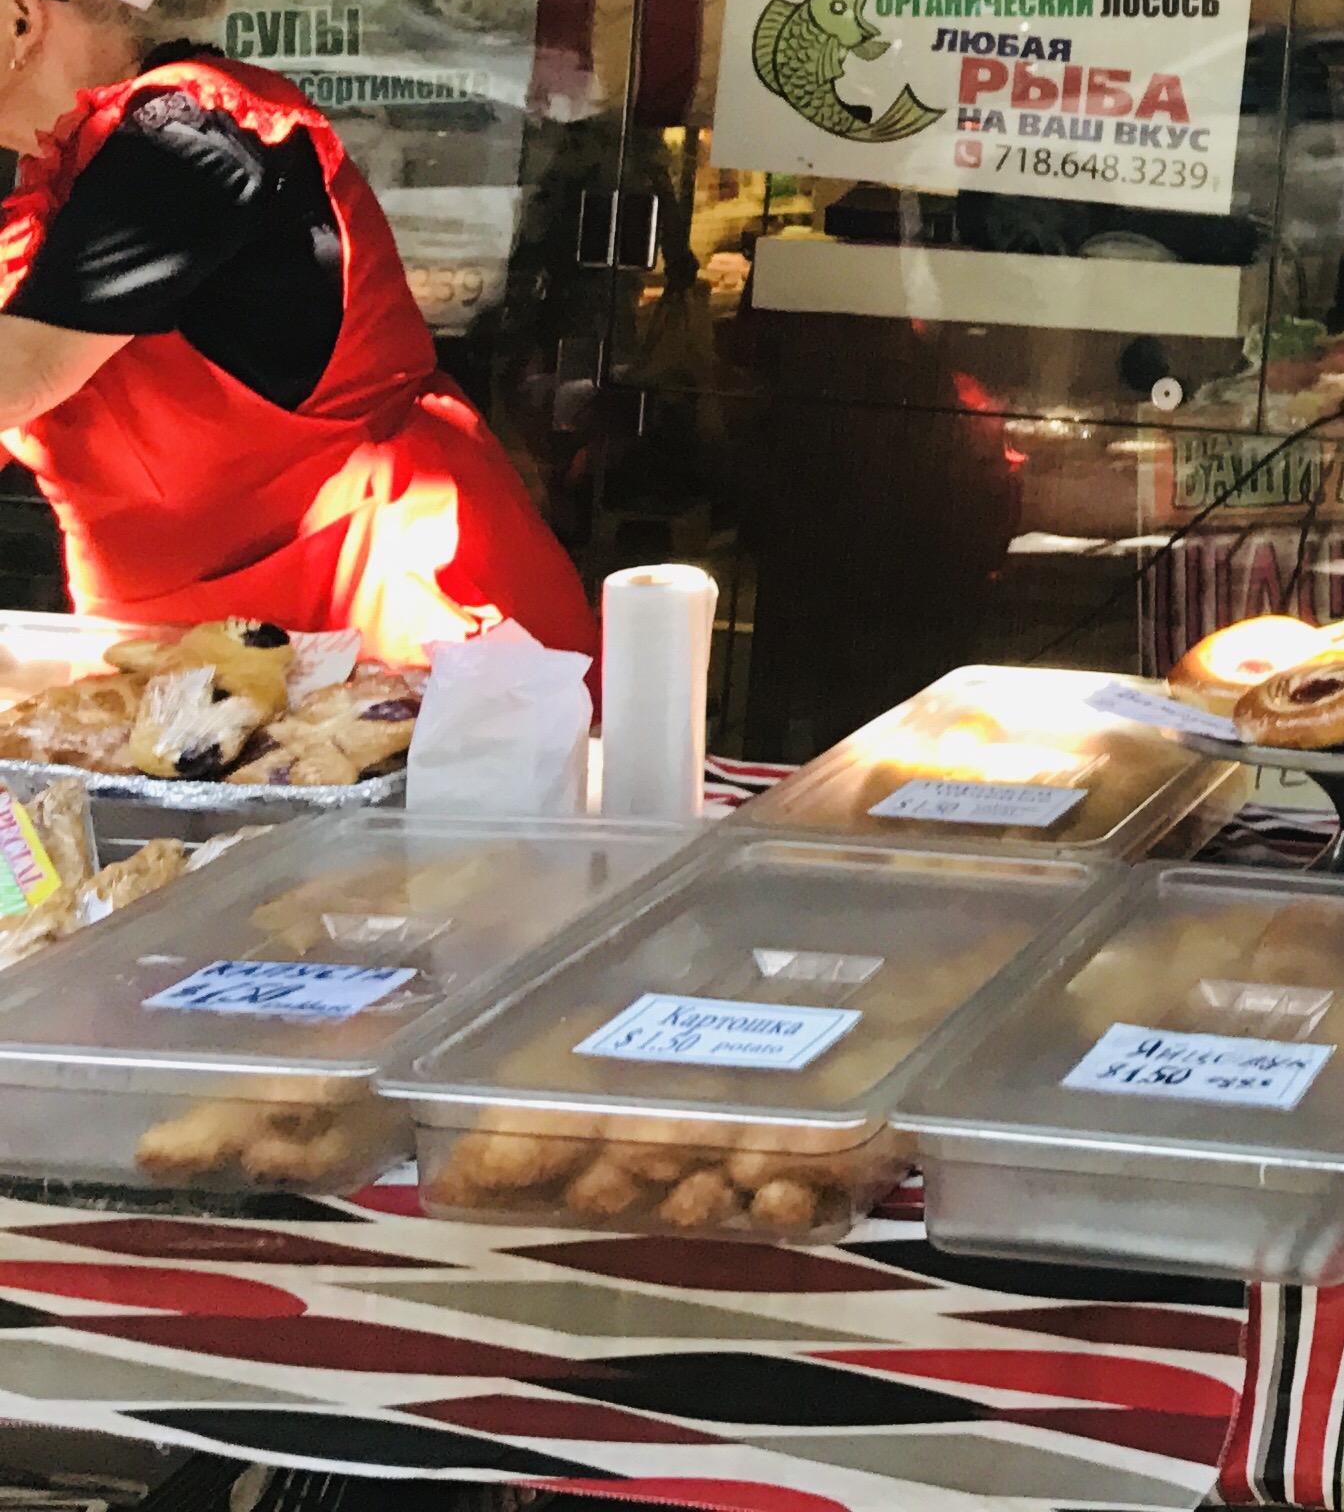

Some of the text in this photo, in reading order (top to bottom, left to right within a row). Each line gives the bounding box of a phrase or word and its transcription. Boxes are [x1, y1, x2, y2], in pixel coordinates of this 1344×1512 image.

[225, 8, 360, 59] СУПЫ
[931, 27, 1073, 63] ЛЮБАЯ
[958, 57, 1191, 124] РЫБА
[957, 108, 1211, 153] НА ВАШ ВКУС
[995, 144, 1209, 189] 718.648.3239
[660, 1004, 805, 1036] Картошка
